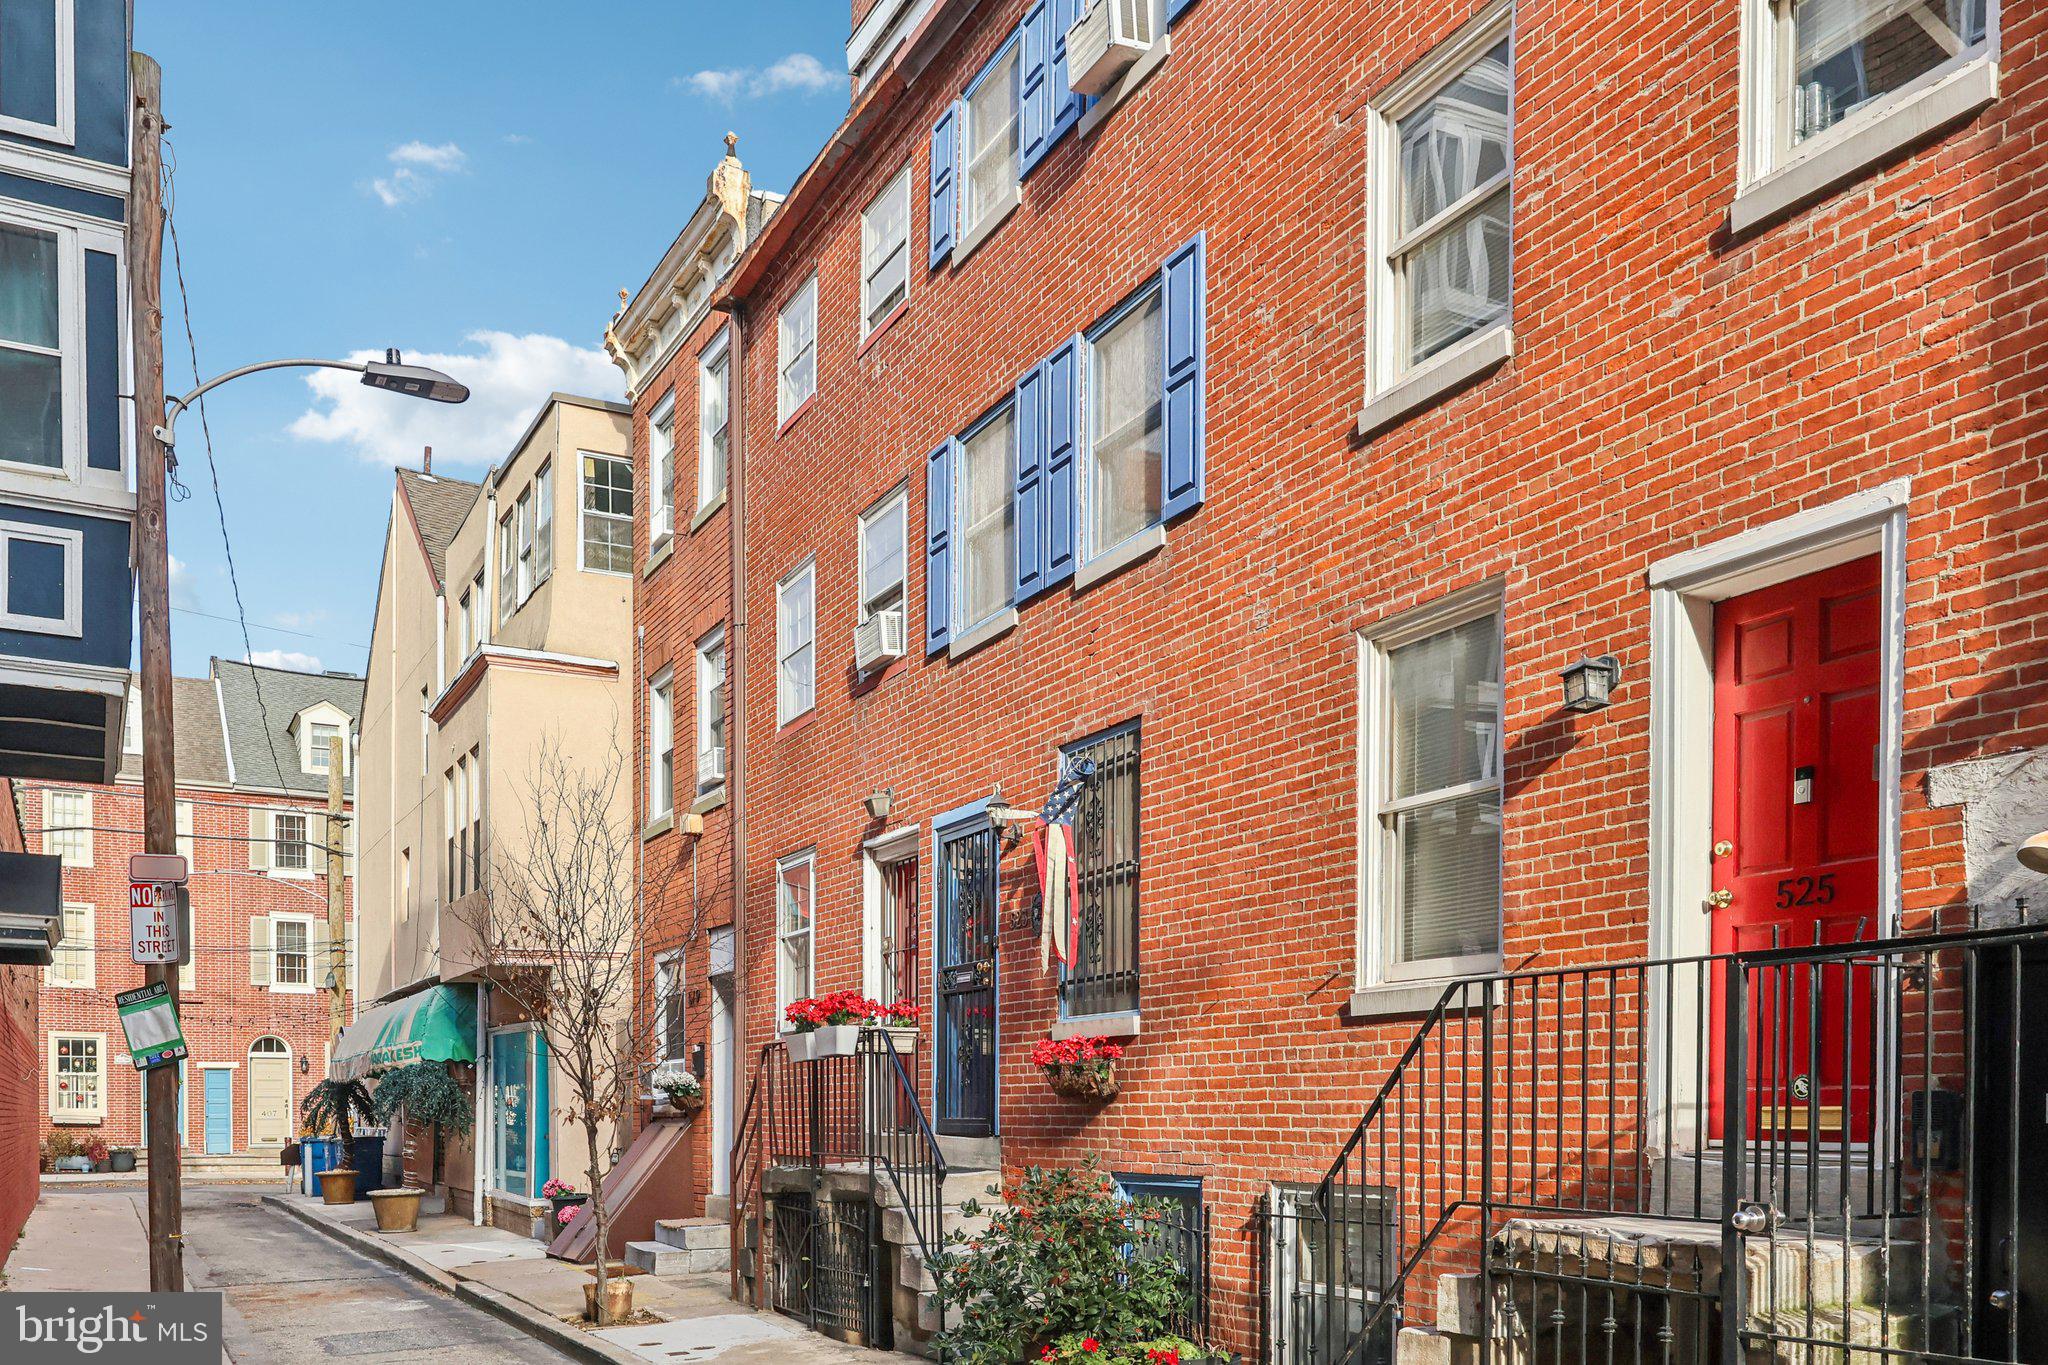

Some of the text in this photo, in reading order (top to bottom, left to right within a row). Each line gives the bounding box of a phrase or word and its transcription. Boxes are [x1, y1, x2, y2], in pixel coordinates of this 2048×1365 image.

[131, 887, 152, 905] NO
[1776, 873, 1835, 909] 525
[153, 911, 165, 923] IN
[145, 924, 171, 938] THIS
[138, 939, 176, 954] STREET
[117, 983, 167, 1005] RESIDENTIAL AREA
